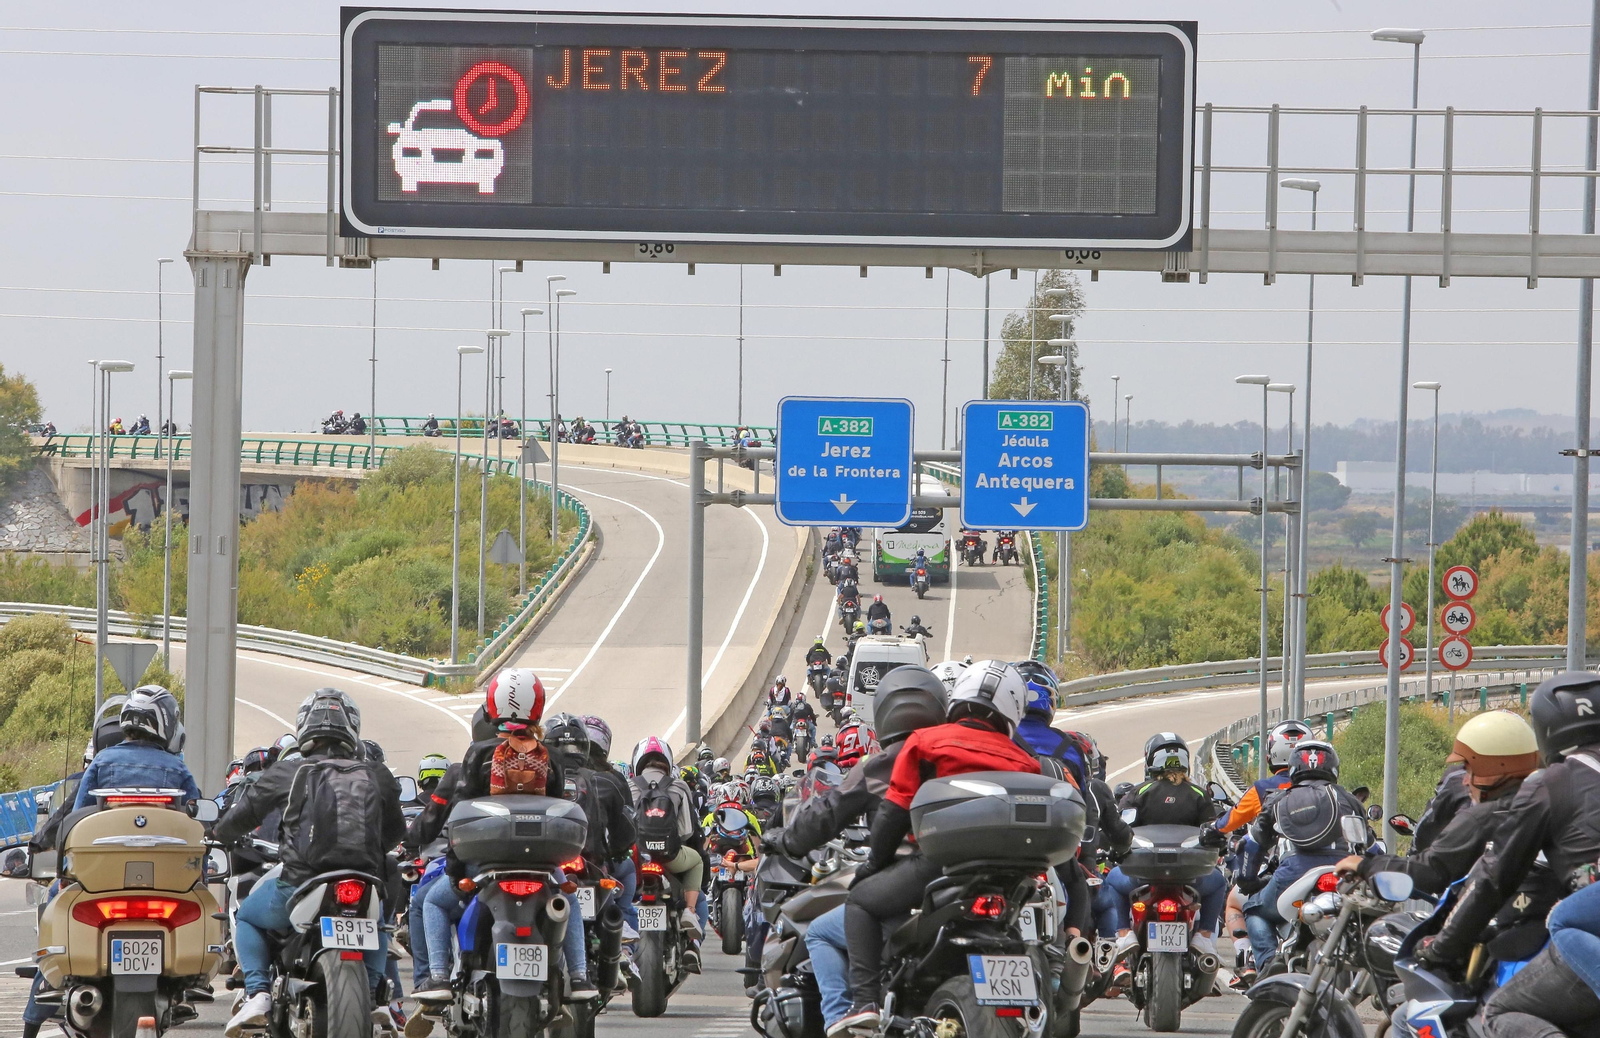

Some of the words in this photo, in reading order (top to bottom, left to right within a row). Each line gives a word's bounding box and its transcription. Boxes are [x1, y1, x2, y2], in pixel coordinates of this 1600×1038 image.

[547, 49, 726, 92] JEREZ
[968, 56, 992, 96] 7
[821, 419, 870, 433] A-382
[1001, 414, 1049, 427] A-382
[1001, 434, 1049, 447] Jédula
[821, 442, 871, 458] Jerez
[997, 452, 1053, 468] Arcos
[787, 465, 807, 477] de
[813, 465, 828, 477] la
[835, 465, 901, 478] Frontera
[975, 472, 1075, 492] Antequera
[645, 841, 666, 851] VANS
[638, 908, 664, 918] 0967
[335, 920, 374, 933] 6915
[640, 918, 659, 928] DPG
[1159, 924, 1185, 936] 1772
[336, 933, 364, 947] HLW
[1160, 935, 1182, 946] HXJ
[122, 941, 159, 956] 6026
[513, 946, 543, 962] 1898
[123, 957, 149, 972] DCV
[513, 962, 540, 977] CZD
[987, 959, 1030, 978] 7723
[989, 978, 1022, 996] KSN
